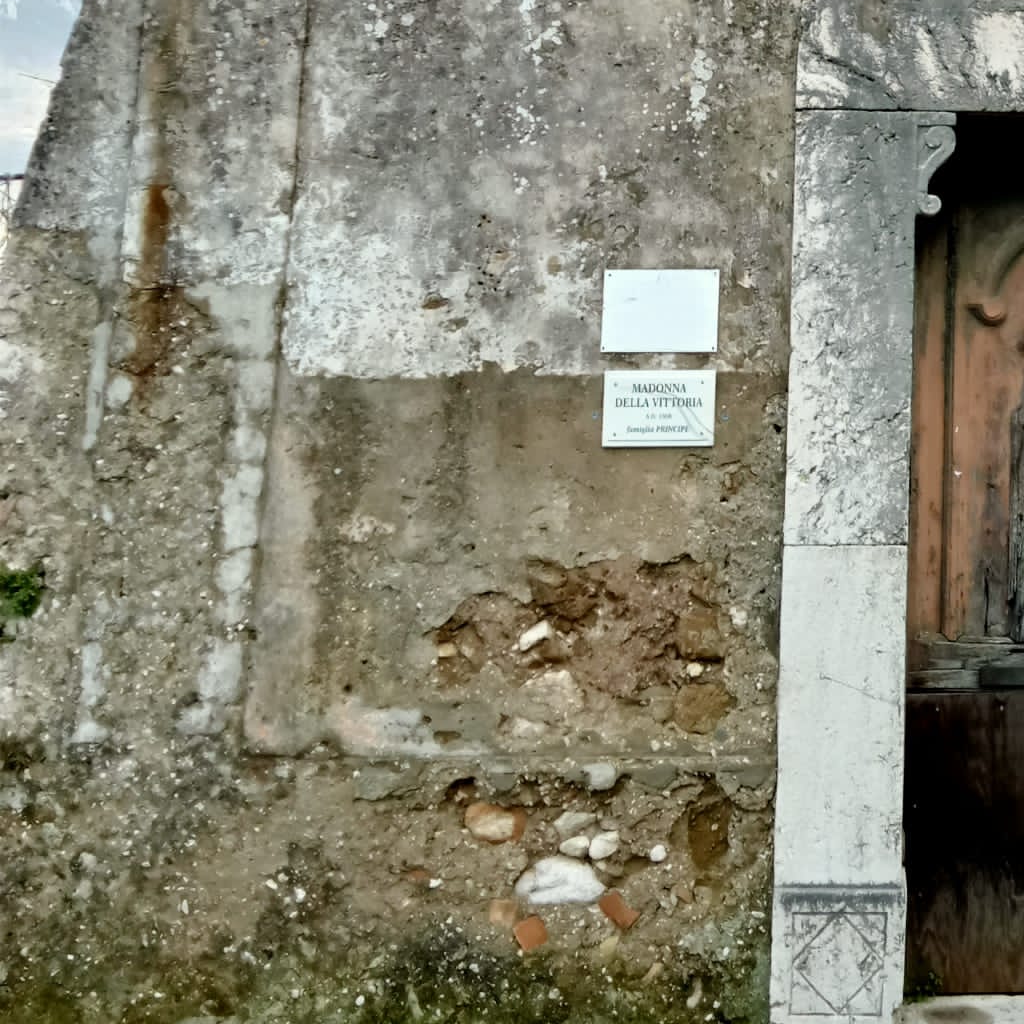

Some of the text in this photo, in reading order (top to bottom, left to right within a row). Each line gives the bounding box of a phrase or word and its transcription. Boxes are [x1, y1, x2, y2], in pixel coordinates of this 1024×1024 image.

[631, 383, 687, 393] MADONNA
[615, 397, 703, 408] DELLA VITTORIA
